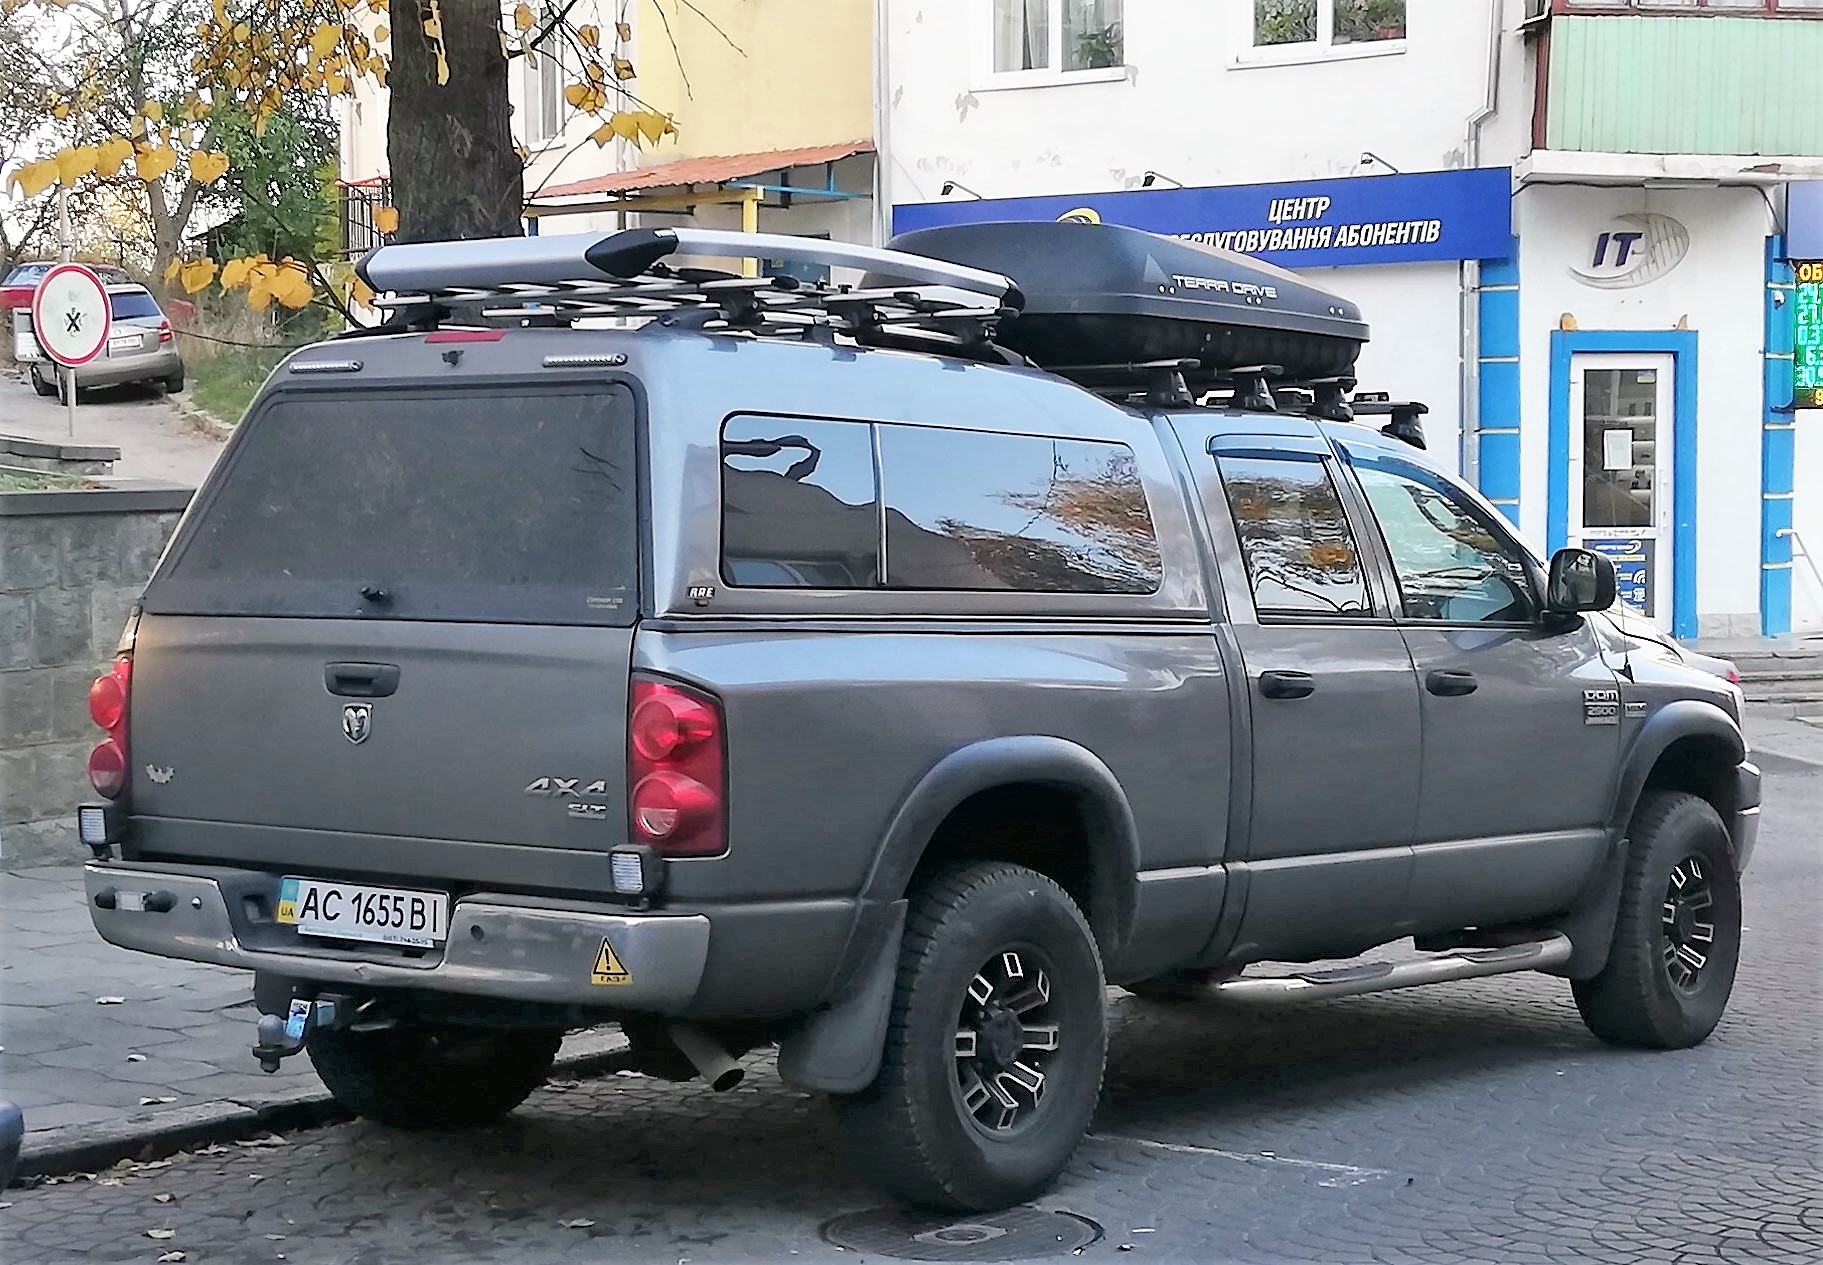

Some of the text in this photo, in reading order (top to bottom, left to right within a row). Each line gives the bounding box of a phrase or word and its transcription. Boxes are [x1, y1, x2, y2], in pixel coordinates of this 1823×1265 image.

[1268, 196, 1331, 225] ЦЕНТР
[1333, 219, 1441, 249] АБОНЕНТІВ
[1592, 232, 1643, 267] IT
[1172, 274, 1278, 299] TERRA DRIVE
[689, 587, 714, 598] ARE
[281, 907, 294, 918] UA
